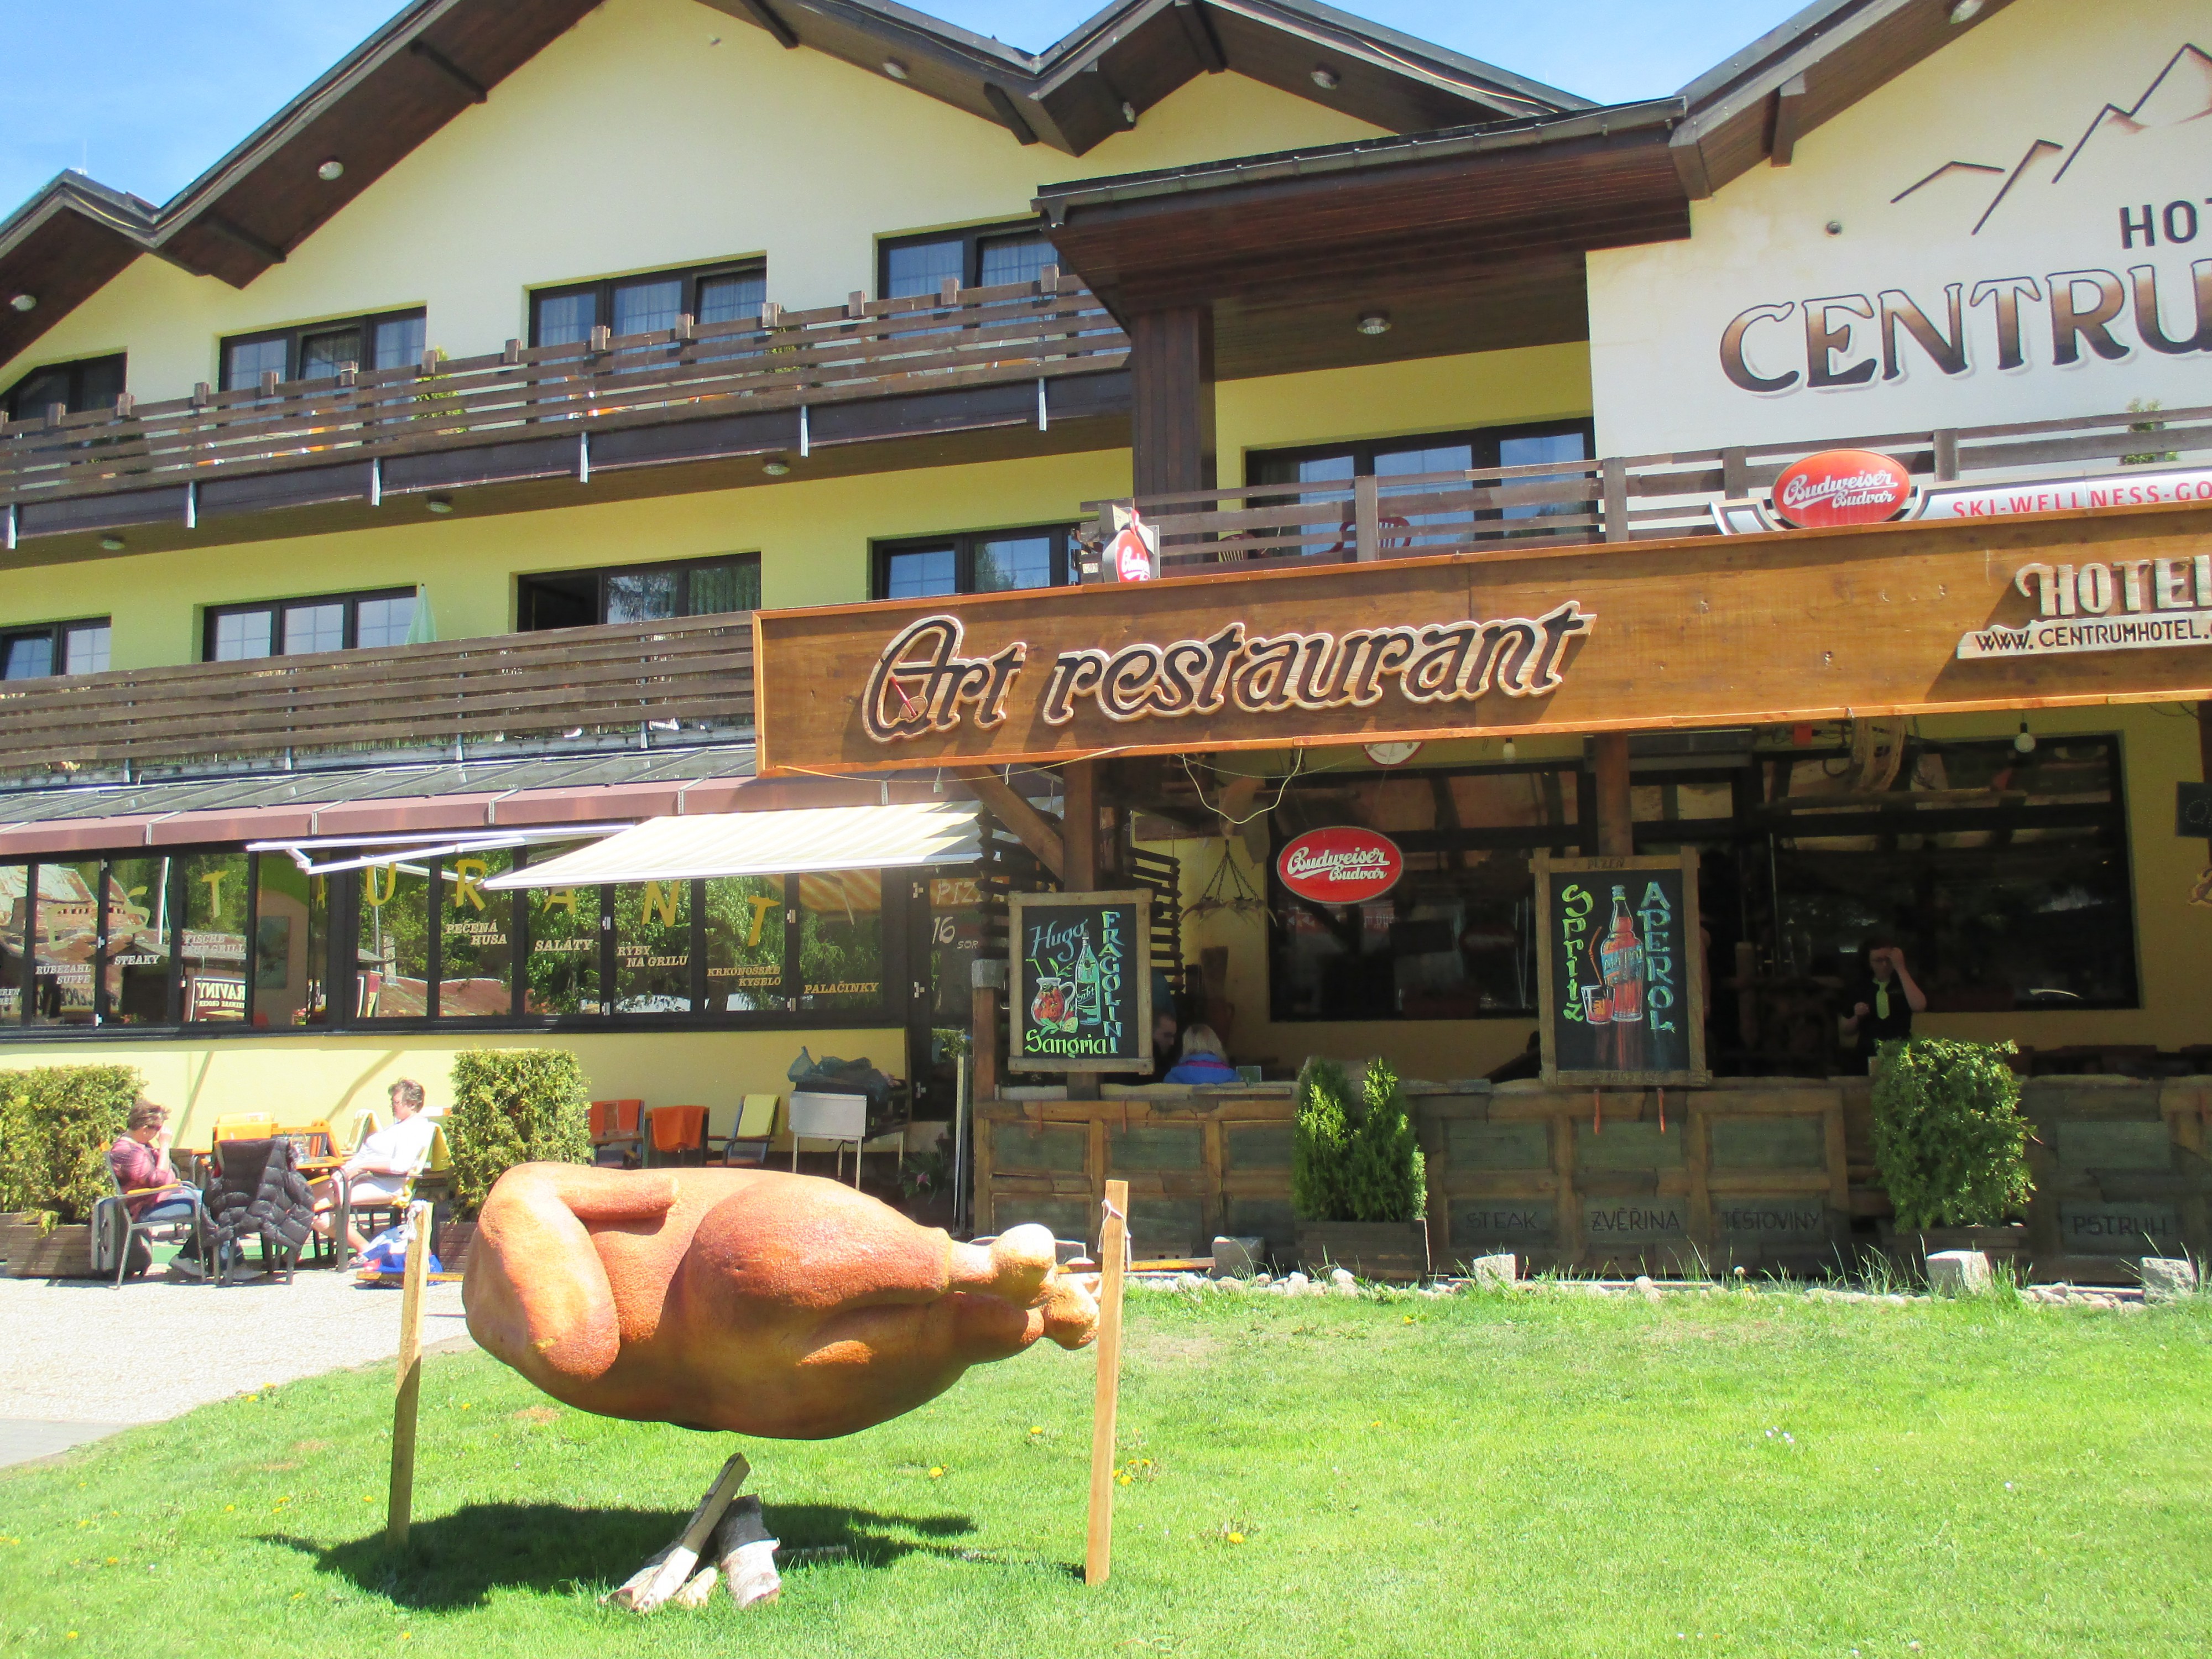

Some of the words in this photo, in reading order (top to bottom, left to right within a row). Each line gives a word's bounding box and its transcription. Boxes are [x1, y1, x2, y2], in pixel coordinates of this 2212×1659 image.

[2119, 197, 2212, 249] HO
[1783, 470, 1898, 505] Budweiser
[1832, 489, 1896, 508] Budvar
[864, 614, 1027, 743] Art
[1044, 601, 1598, 726] restaurant
[1287, 847, 1391, 875] Budweiser
[1329, 864, 1387, 881] Budvar
[445, 919, 498, 934] PEČENÁ
[931, 916, 955, 944] 16
[471, 934, 507, 945] HUSA
[535, 936, 594, 952] SALÁTY
[1029, 918, 1088, 962] Hugo
[113, 954, 160, 965] STEAKY
[617, 945, 653, 956] RYBY
[1636, 881, 1675, 1032] APEROL
[35, 963, 91, 974] RÜBEZAHL
[626, 957, 644, 967] NA
[648, 956, 689, 967] GRILU
[56, 975, 90, 984] SUPPE
[739, 978, 781, 987] KYSELO
[804, 980, 879, 994] PALAČINKY
[1098, 911, 1124, 1053] FRAGOLINI
[1025, 1029, 1107, 1058] Sangria
[1466, 1211, 1537, 1229] STEAK
[1591, 1208, 1680, 1230] ZVĚŘINA
